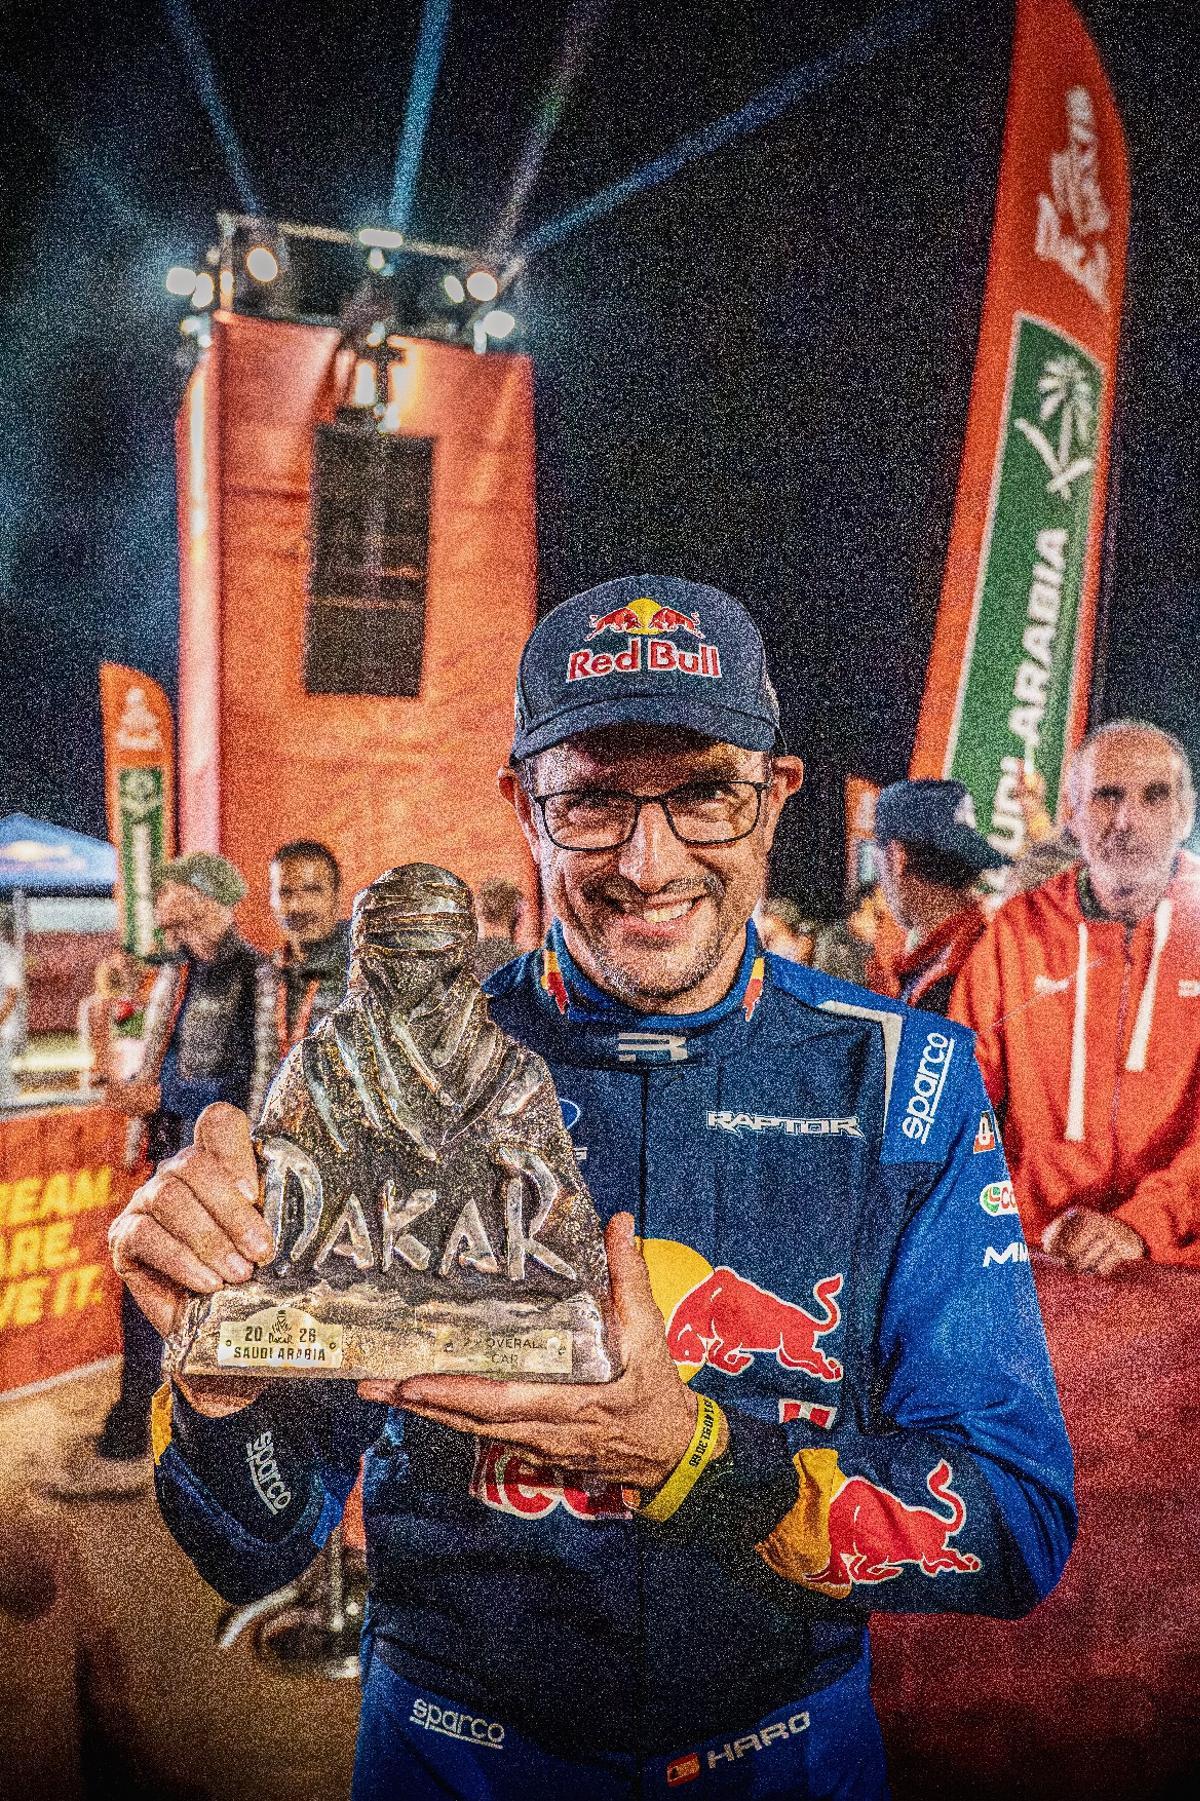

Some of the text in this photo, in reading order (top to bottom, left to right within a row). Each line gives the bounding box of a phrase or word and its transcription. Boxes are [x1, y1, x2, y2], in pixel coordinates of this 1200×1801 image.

[566, 638, 722, 683] Red Bull
[1008, 528, 1068, 747] ARABIA
[902, 1032, 954, 1144] sparco
[706, 1110, 866, 1143] RAPTOR
[262, 1137, 577, 1282] DAKAR
[0, 1220, 80, 1278] RE.
[233, 1346, 326, 1361] SAUDI ARABIA
[244, 1325, 262, 1342] 20
[244, 1430, 291, 1514] sparco
[410, 1698, 505, 1748] sparco
[707, 1711, 811, 1769] HARO
